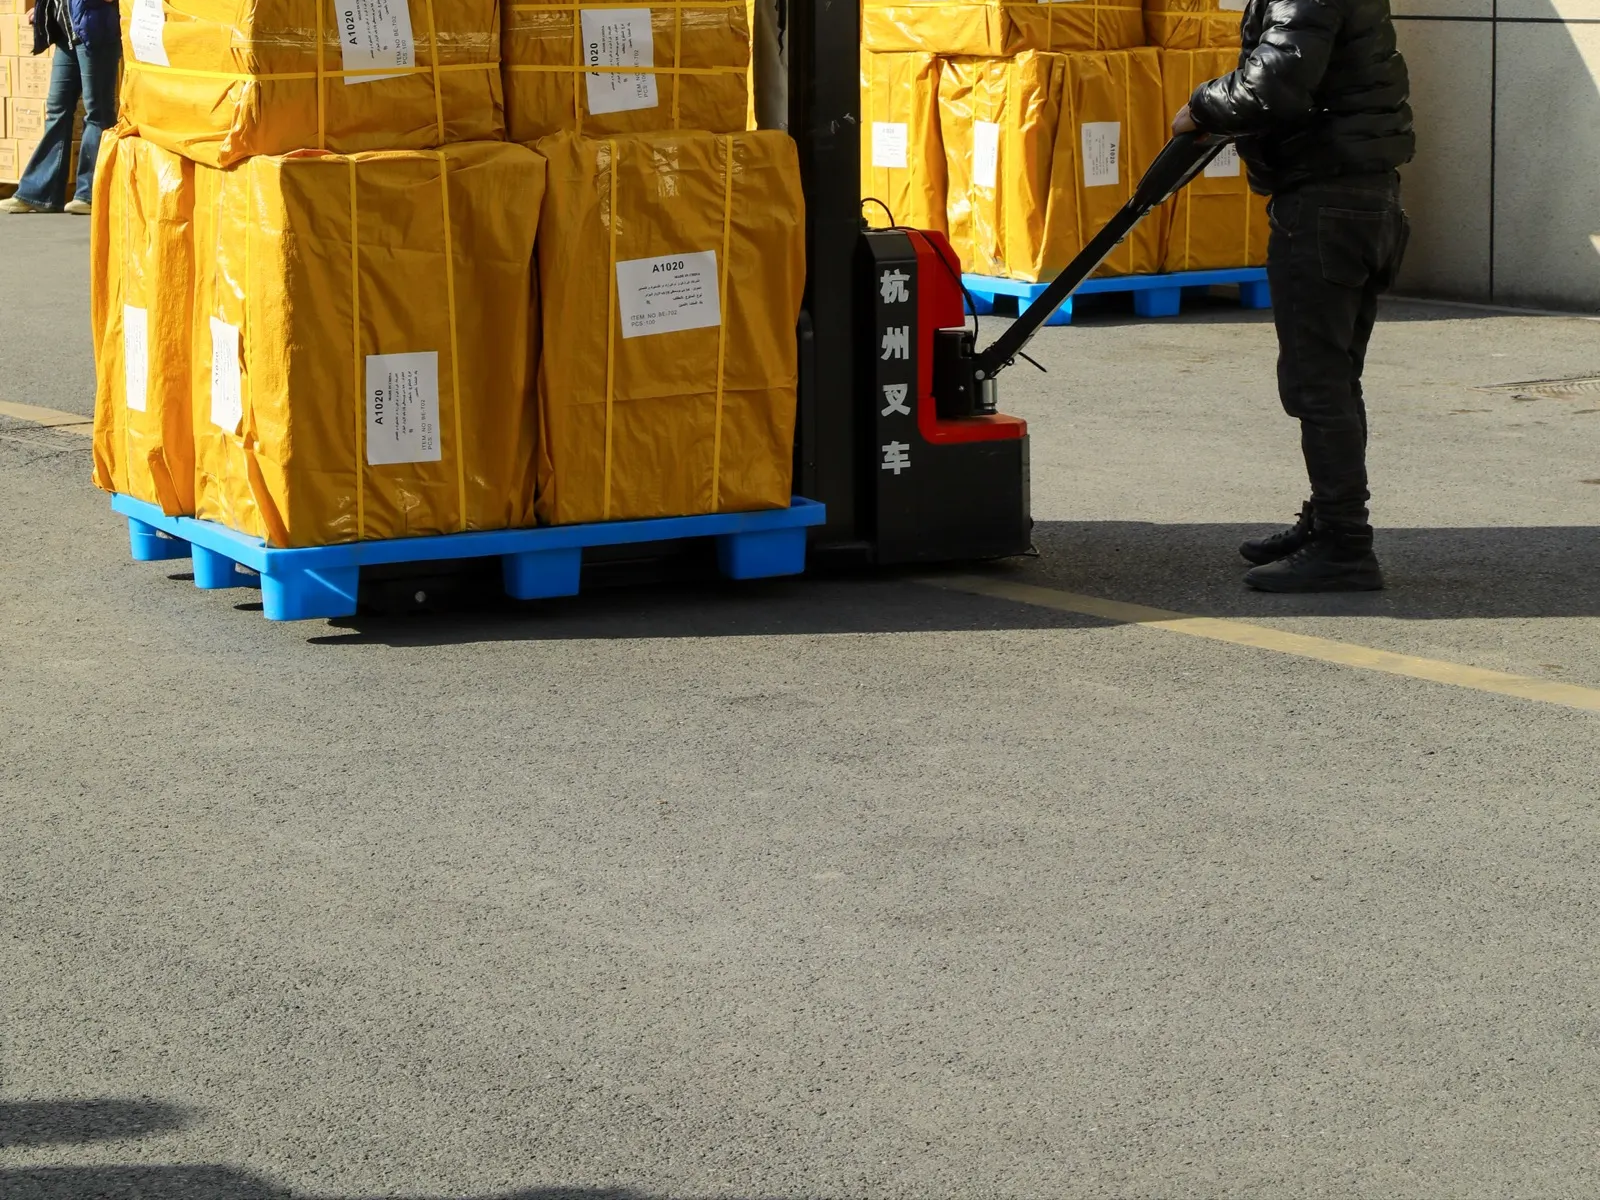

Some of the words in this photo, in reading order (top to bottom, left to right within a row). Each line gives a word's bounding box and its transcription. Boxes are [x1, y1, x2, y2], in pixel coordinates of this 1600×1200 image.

[345, 10, 357, 45] A1020
[652, 261, 684, 273] A1020
[879, 268, 911, 476] 杭州叉车
[375, 390, 383, 425] A1020
